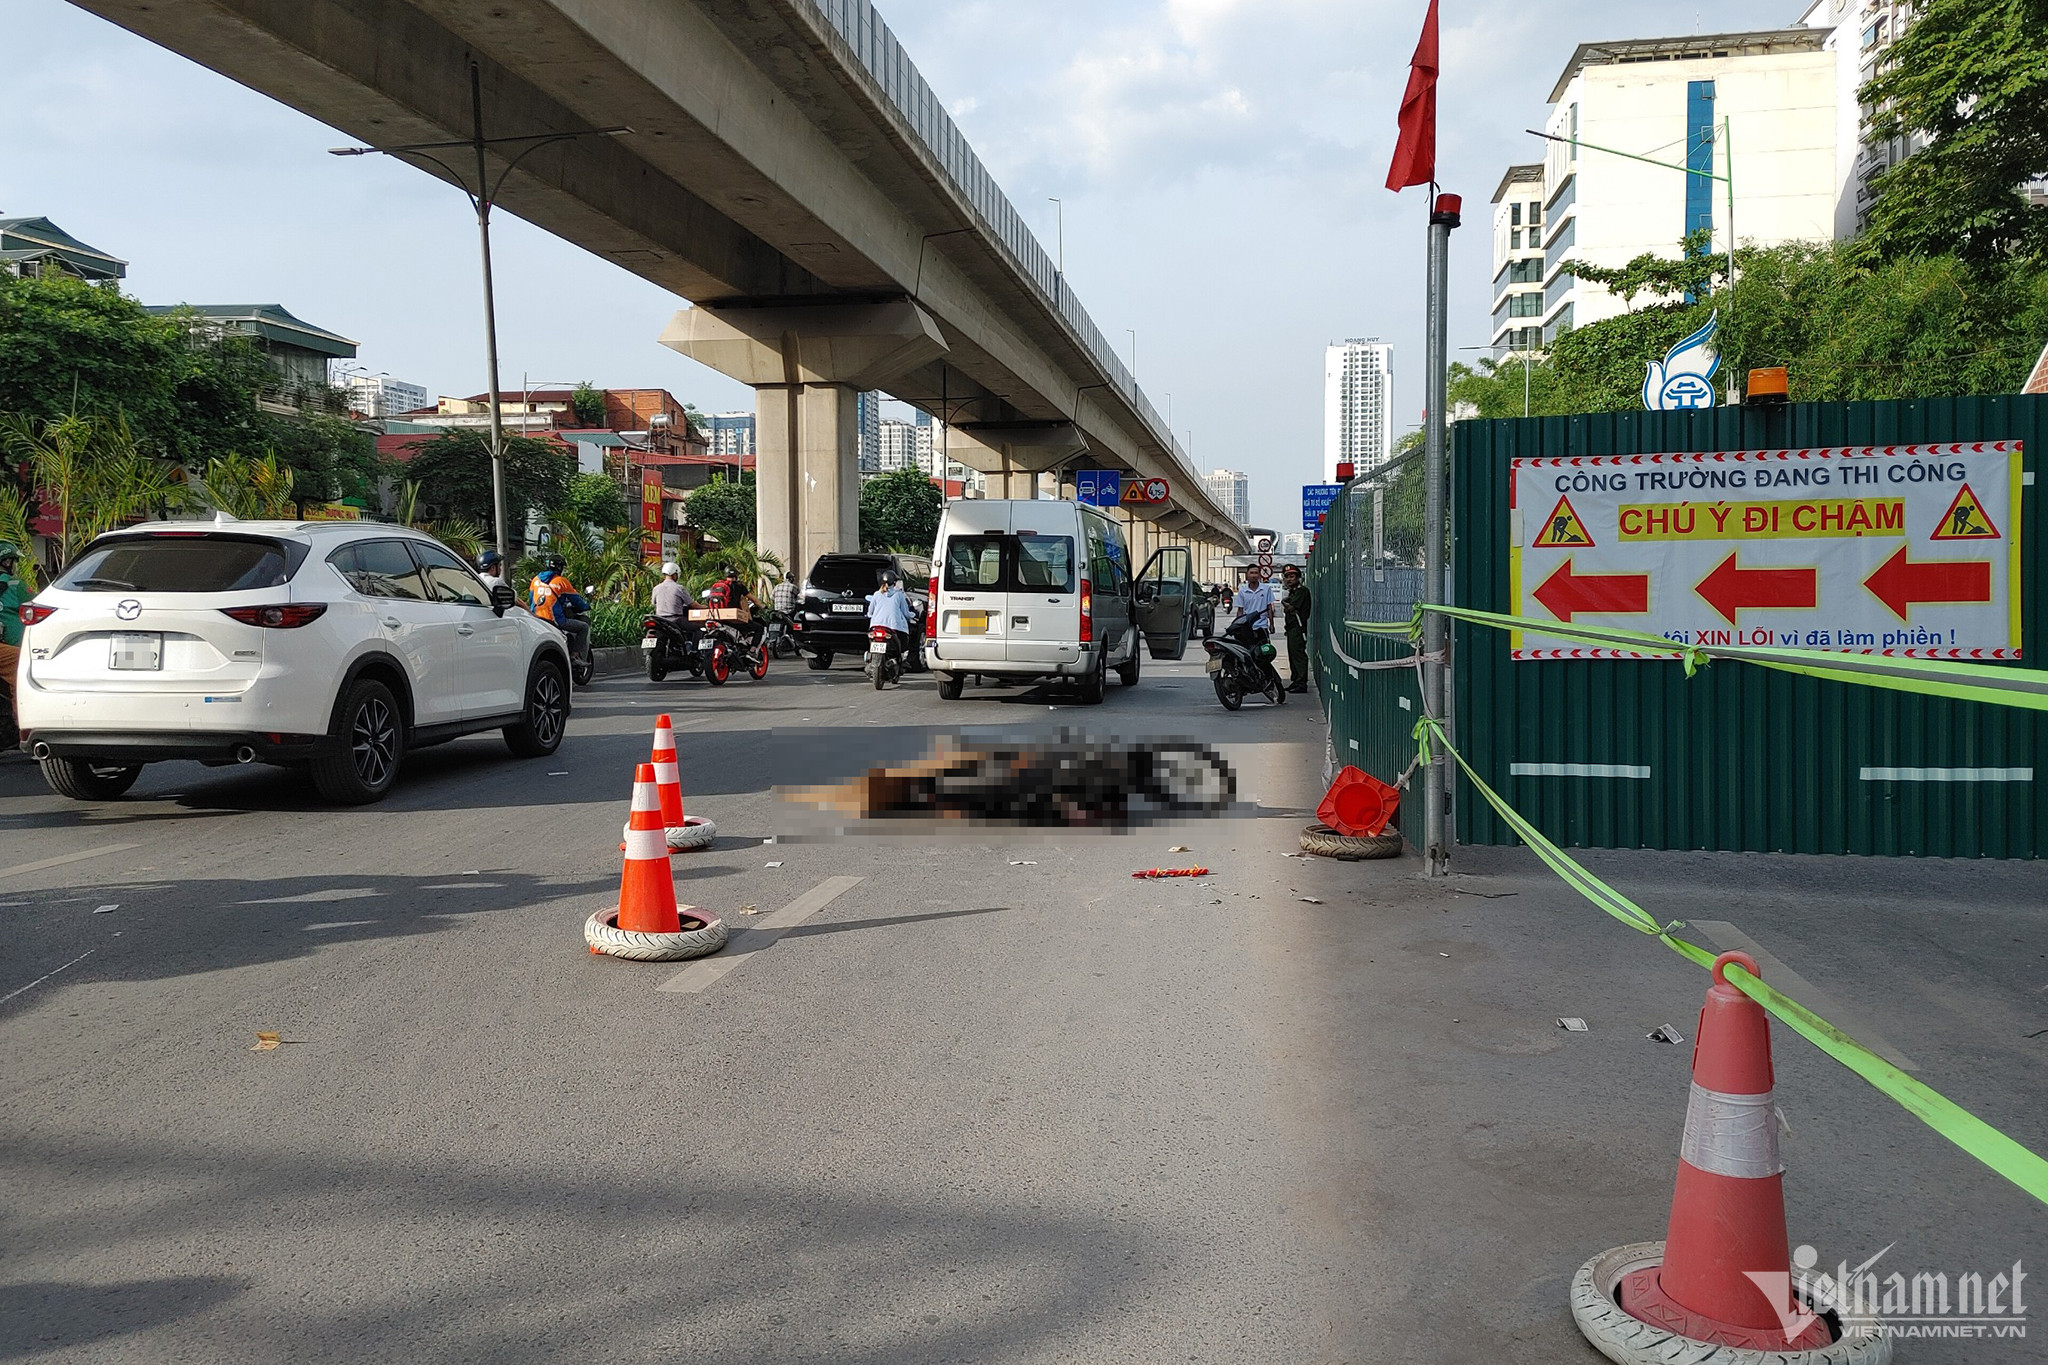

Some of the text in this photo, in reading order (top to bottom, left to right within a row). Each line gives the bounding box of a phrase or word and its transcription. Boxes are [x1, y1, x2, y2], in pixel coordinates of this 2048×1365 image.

[1555, 459, 1966, 492] CÔNG TRƯỜNG ĐANG THI CÔNG
[1619, 499, 1904, 537] CHÚ Ý ĐI CHẬM
[1696, 630, 1730, 645] XIN
[1739, 626, 1773, 645] LỖI
[1780, 630, 1799, 645] vì
[1806, 630, 1831, 645] đã
[1838, 630, 1875, 645] làm
[1882, 625, 1942, 648] phiền
